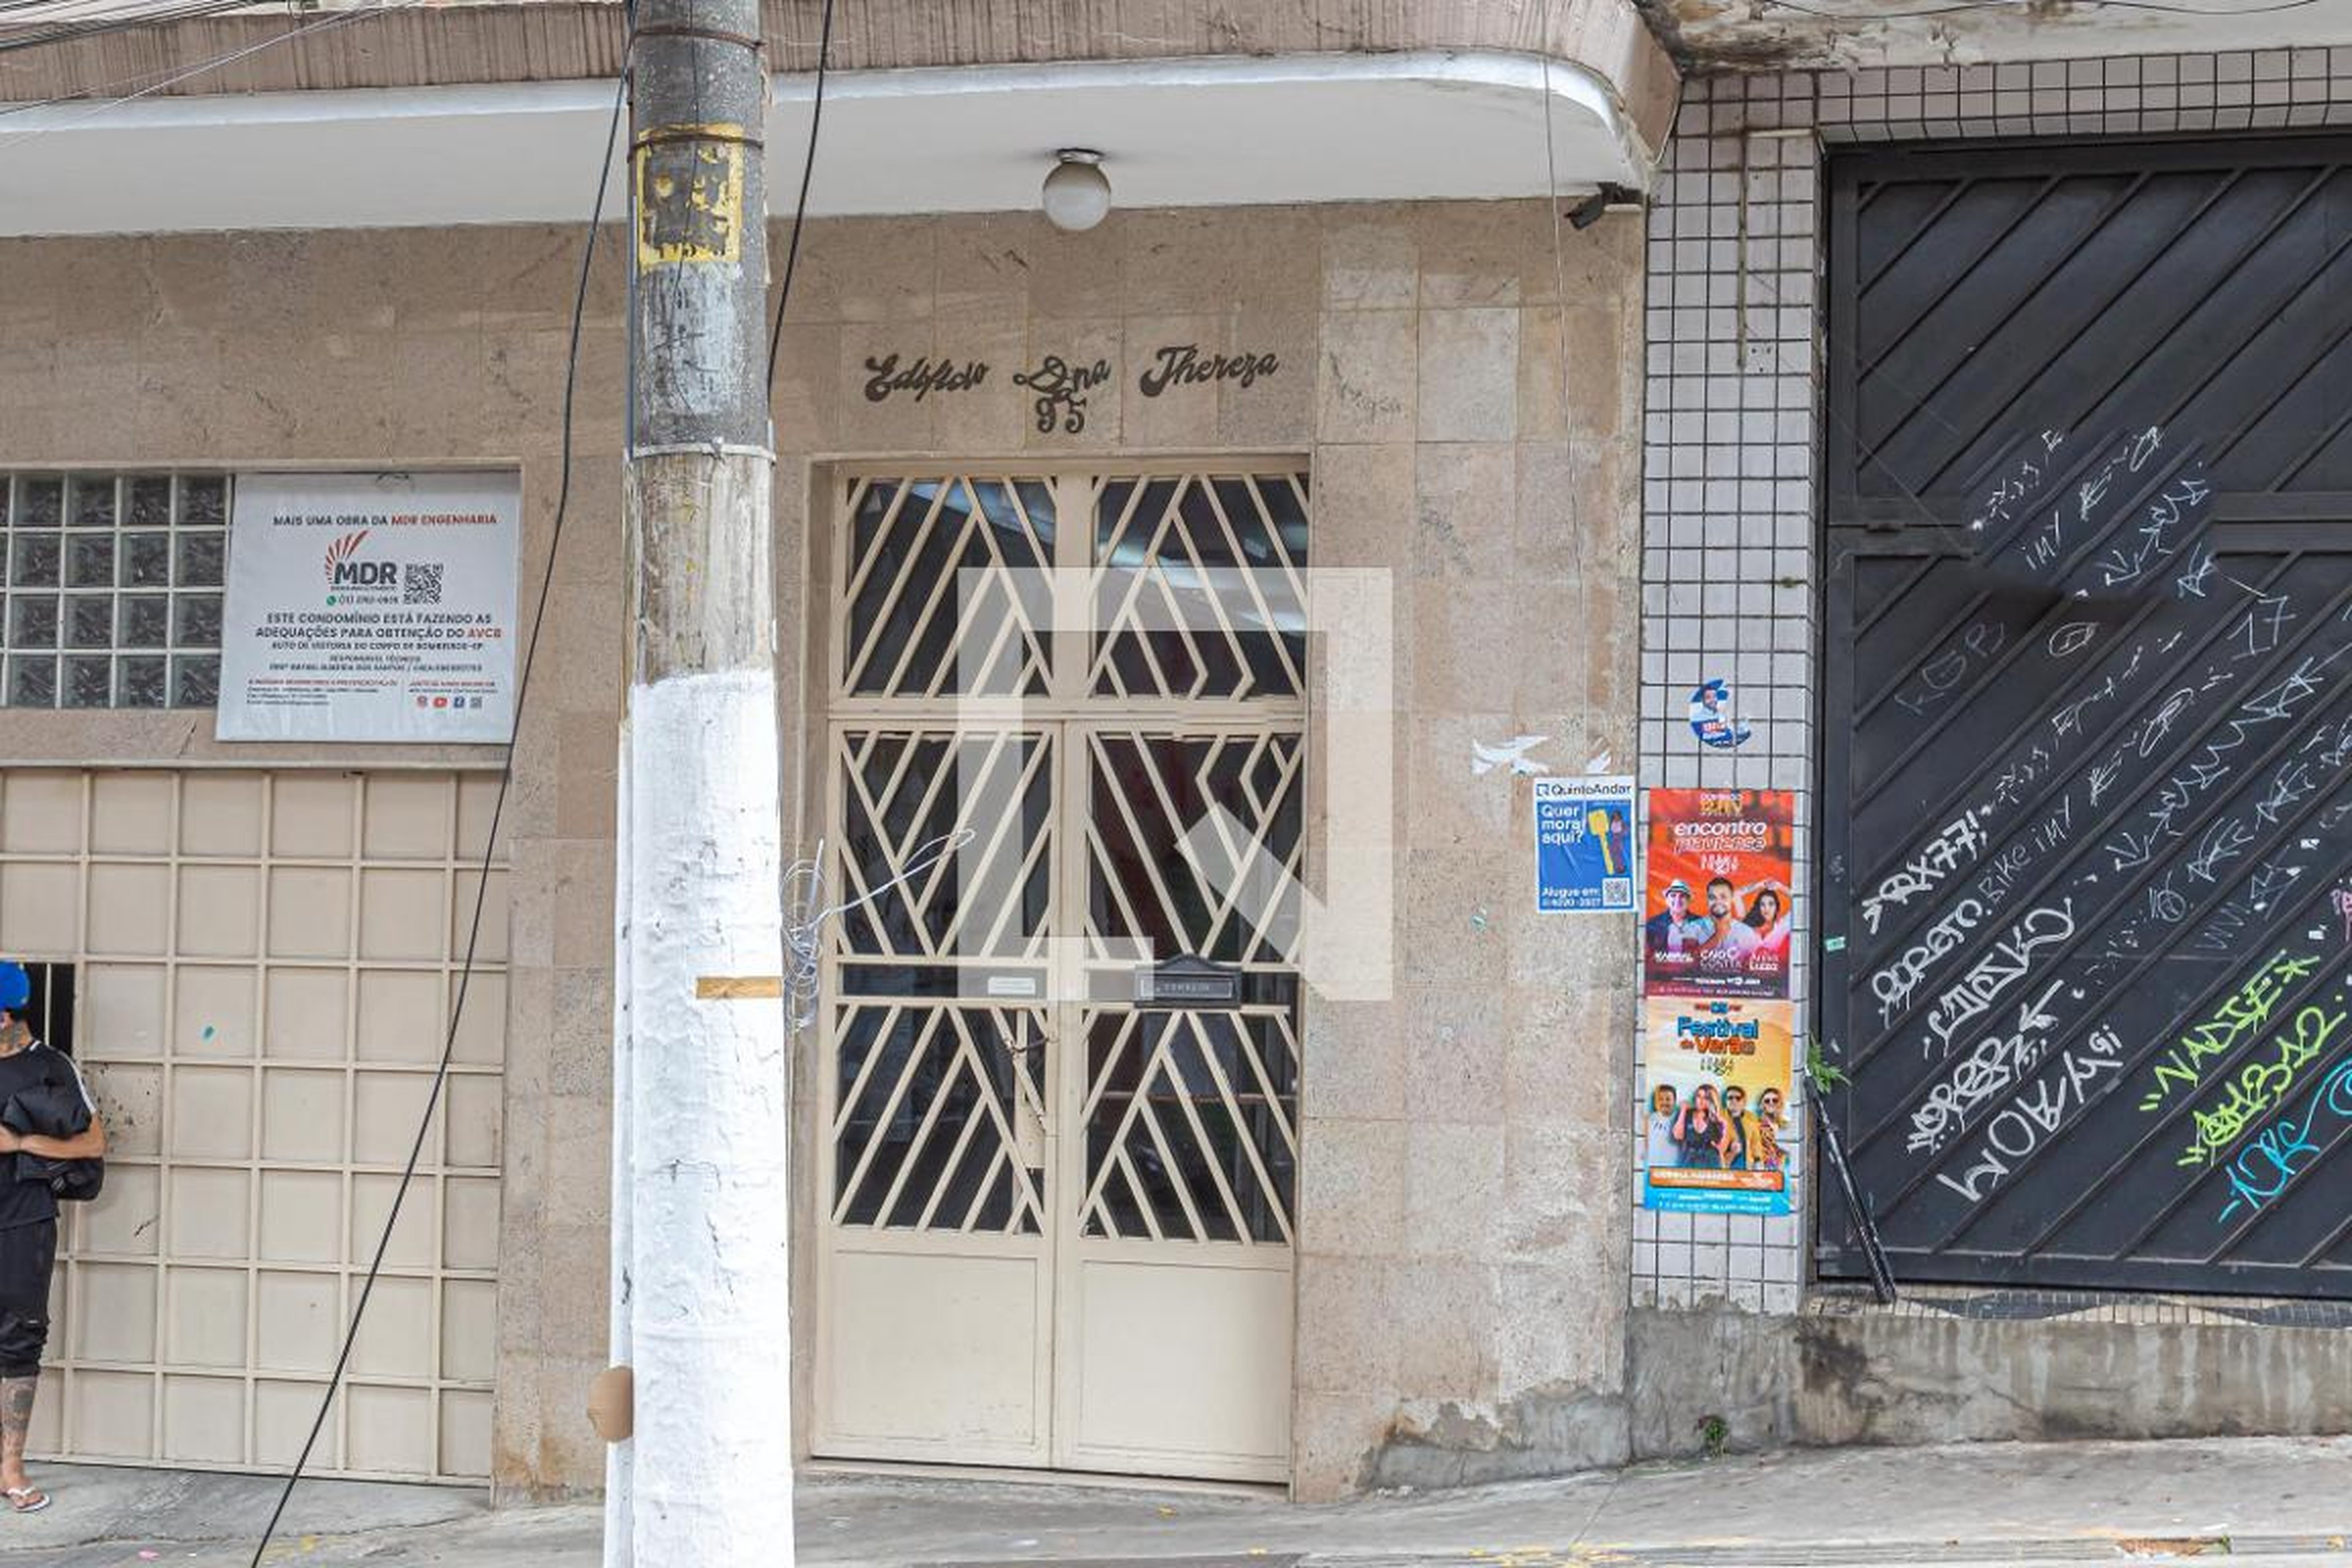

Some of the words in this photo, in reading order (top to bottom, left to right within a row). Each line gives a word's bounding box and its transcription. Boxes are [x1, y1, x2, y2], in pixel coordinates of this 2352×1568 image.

[1140, 344, 1279, 397] Thereza
[1036, 397, 1087, 434] 95
[273, 516, 303, 526] MAIS
[307, 516, 332, 525] UMA
[336, 515, 368, 525] OBRA
[371, 515, 388, 525] DA
[391, 514, 419, 525] MDR
[421, 513, 497, 525] ENGENHARIA
[333, 562, 398, 584] MDR
[267, 612, 295, 624] ESTE
[299, 611, 380, 624] CONDOMÍNIO
[383, 611, 413, 624] ESTÁ
[417, 612, 472, 624] FAZENDO
[475, 612, 491, 624] AS
[255, 626, 337, 640] ADEQUAÇÕES
[341, 628, 373, 638] PARA
[375, 626, 442, 641] OBTENÇÃO
[446, 628, 465, 638] DO
[1551, 784, 1631, 795] QuintoAndar
[1541, 804, 1578, 817] Quer
[1674, 820, 1767, 836] encontro
[1542, 831, 1583, 846] aqui?
[1677, 1016, 1758, 1039] Festival
[1695, 1035, 1756, 1055] Verão
